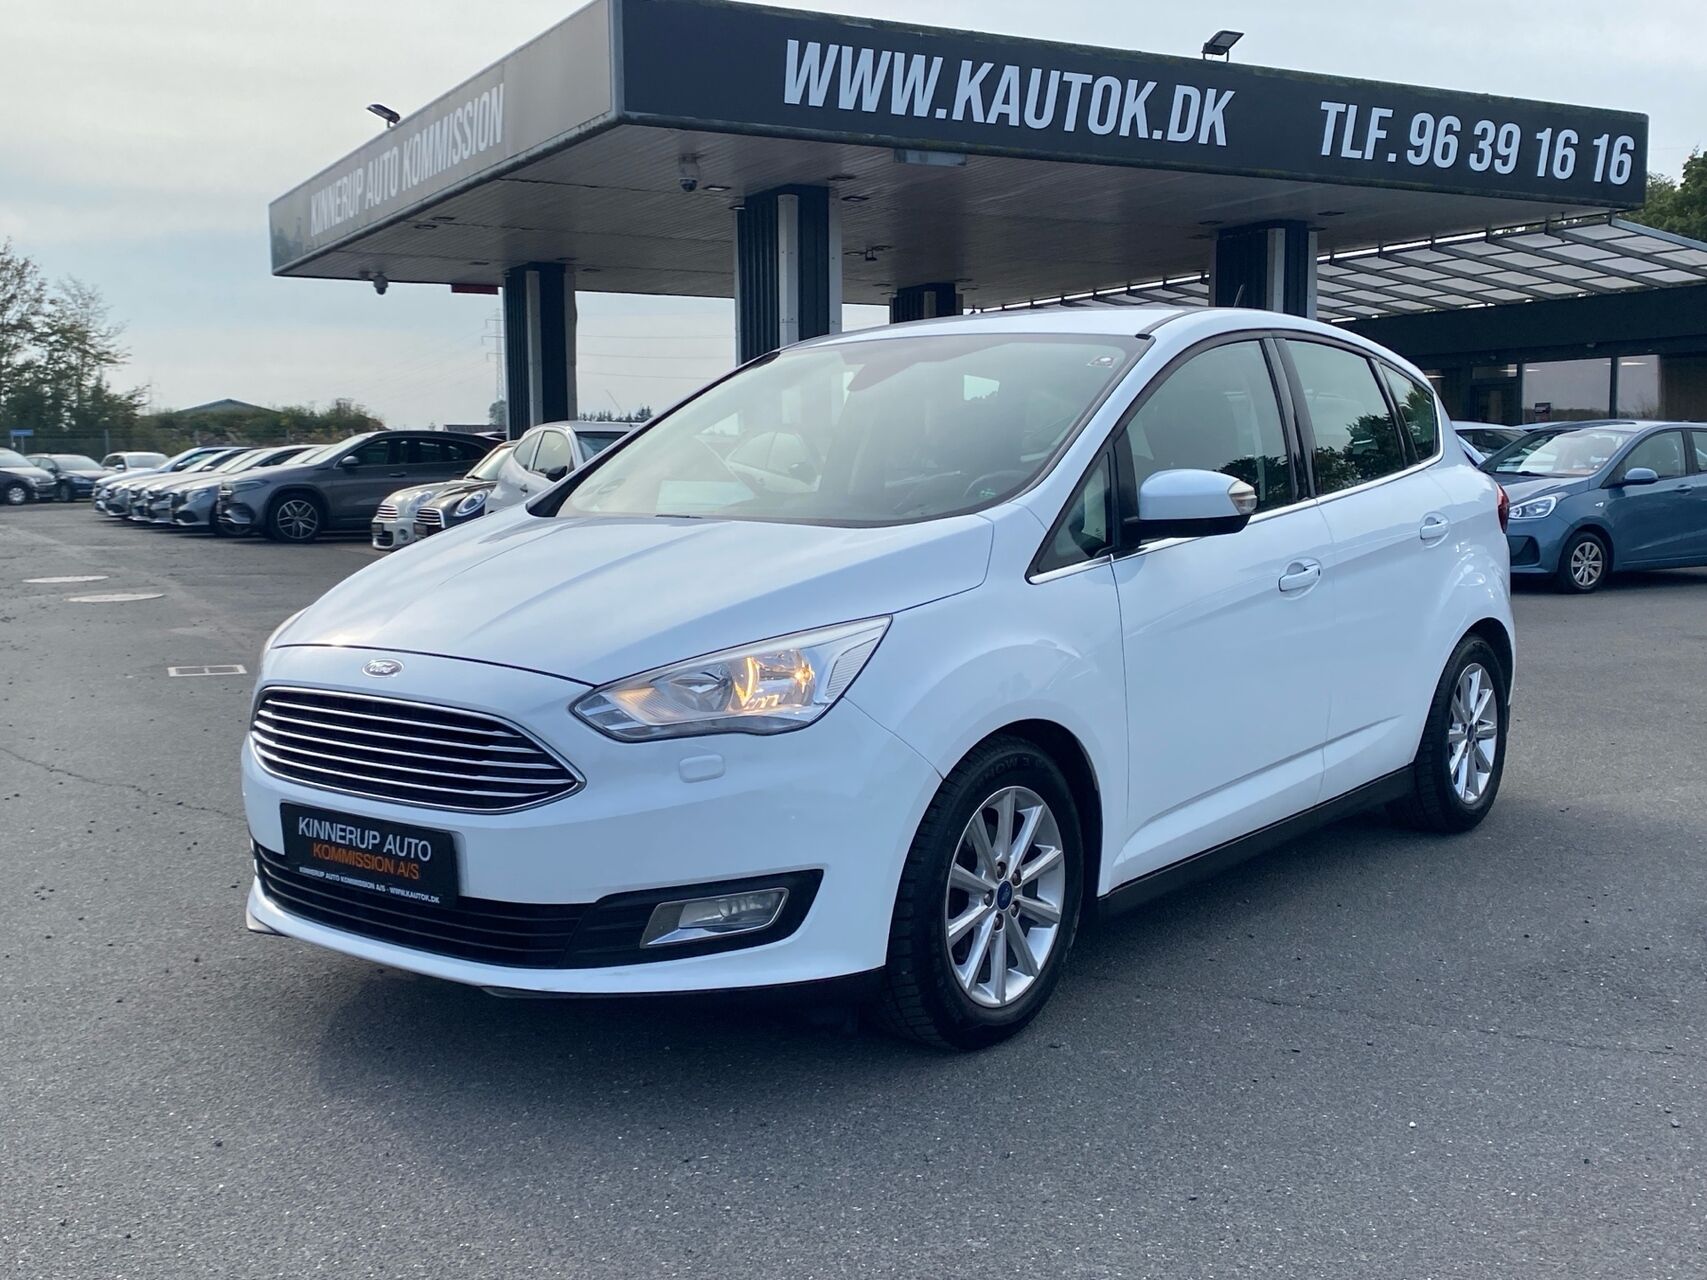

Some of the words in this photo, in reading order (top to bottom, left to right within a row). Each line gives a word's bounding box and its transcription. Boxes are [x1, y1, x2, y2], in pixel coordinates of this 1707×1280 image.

[783, 39, 1236, 146] WWW.KAUTOK.DK
[310, 167, 364, 237] KINNERUP
[365, 146, 400, 210] AUTO
[402, 83, 505, 191] KOMMISSION
[1320, 101, 1397, 163] TLF.
[1406, 112, 1462, 169] 96
[1469, 119, 1521, 175] 39
[1535, 127, 1579, 180] 16
[1592, 133, 1635, 186] 16
[298, 816, 380, 849] KINNERUP
[383, 833, 432, 862] AUTO
[312, 843, 394, 873] KOMMISSION
[397, 860, 420, 880] A/S
